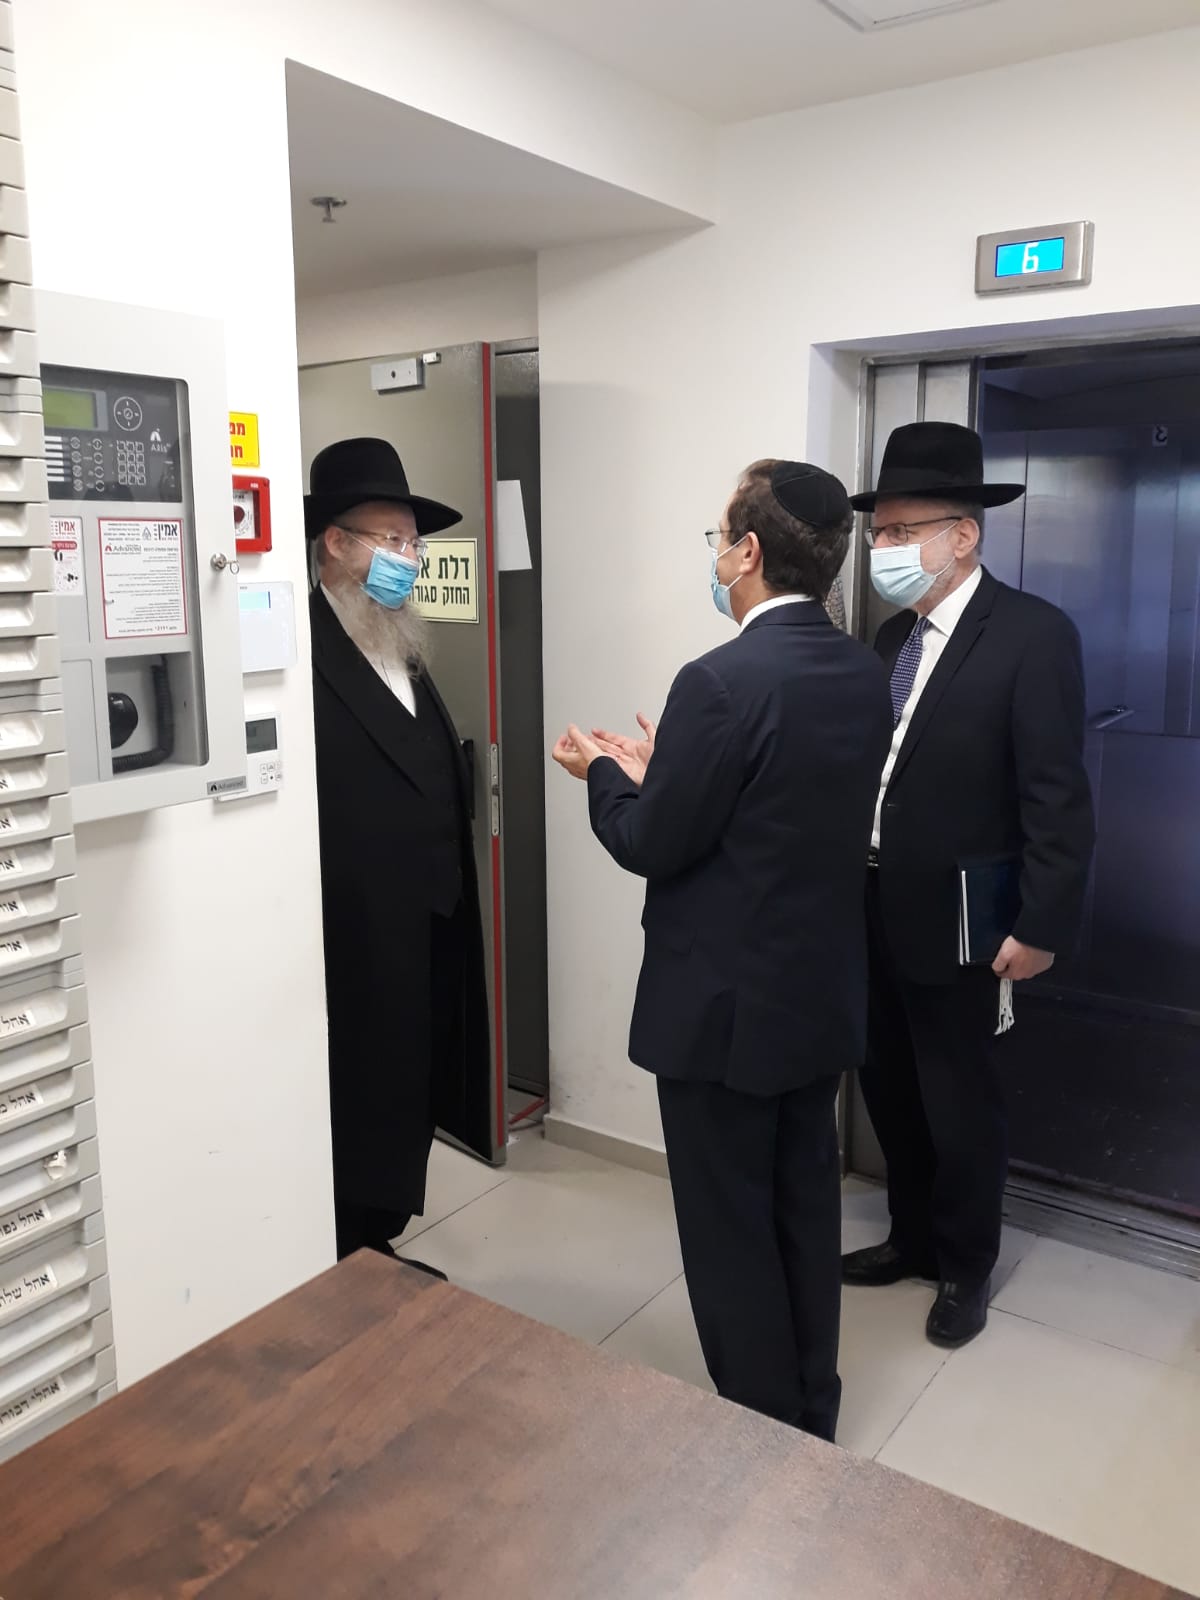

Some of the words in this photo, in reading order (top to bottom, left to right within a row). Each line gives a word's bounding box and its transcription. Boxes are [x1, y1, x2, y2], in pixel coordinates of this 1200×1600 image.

[1022, 241, 1039, 273] 6
[157, 523, 177, 541] אמין
[438, 554, 470, 580] דלת
[442, 586, 470, 606] החזק
[8, 1092, 36, 1109] אהל
[18, 1209, 45, 1227] אהל
[23, 1274, 50, 1292] אהל
[31, 1382, 60, 1403] אהלי
